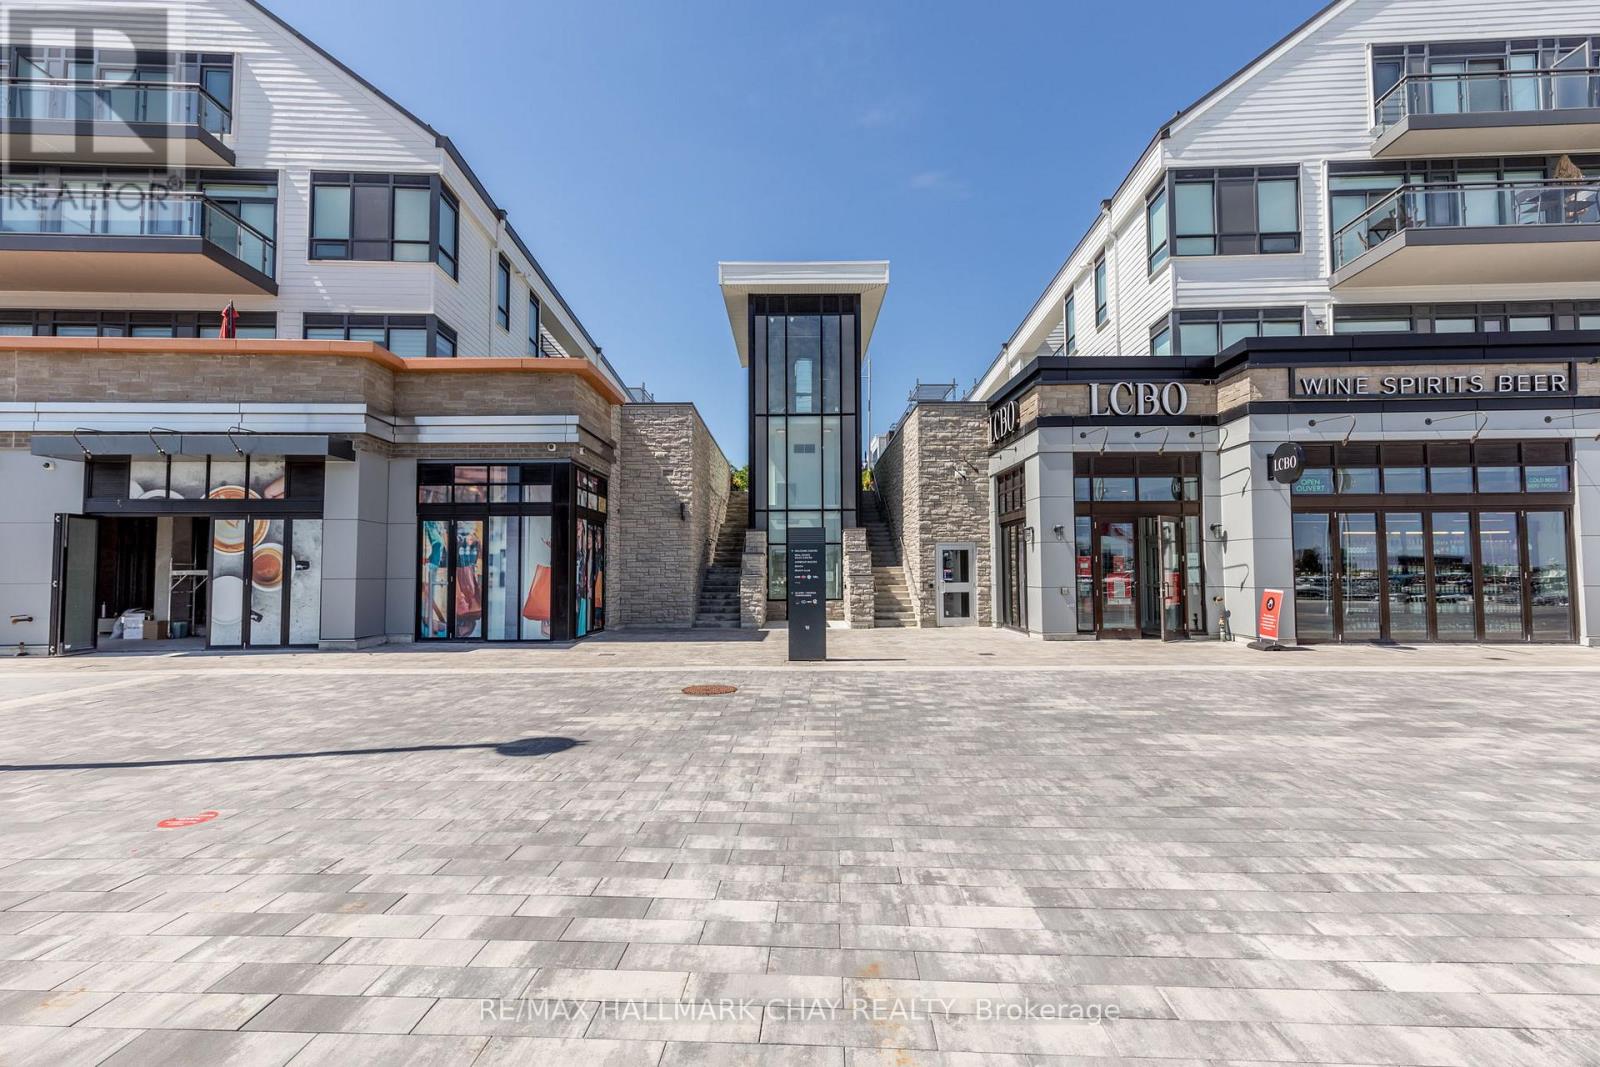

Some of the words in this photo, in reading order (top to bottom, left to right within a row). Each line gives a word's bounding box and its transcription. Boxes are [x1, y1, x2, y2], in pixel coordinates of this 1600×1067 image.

[1301, 377, 1369, 395] WINE
[1382, 375, 1483, 394] SPIRITS
[1498, 374, 1567, 392] BEER
[1089, 382, 1188, 416] LCBO
[988, 400, 1016, 446] LCBO
[1274, 456, 1297, 472] LCBO
